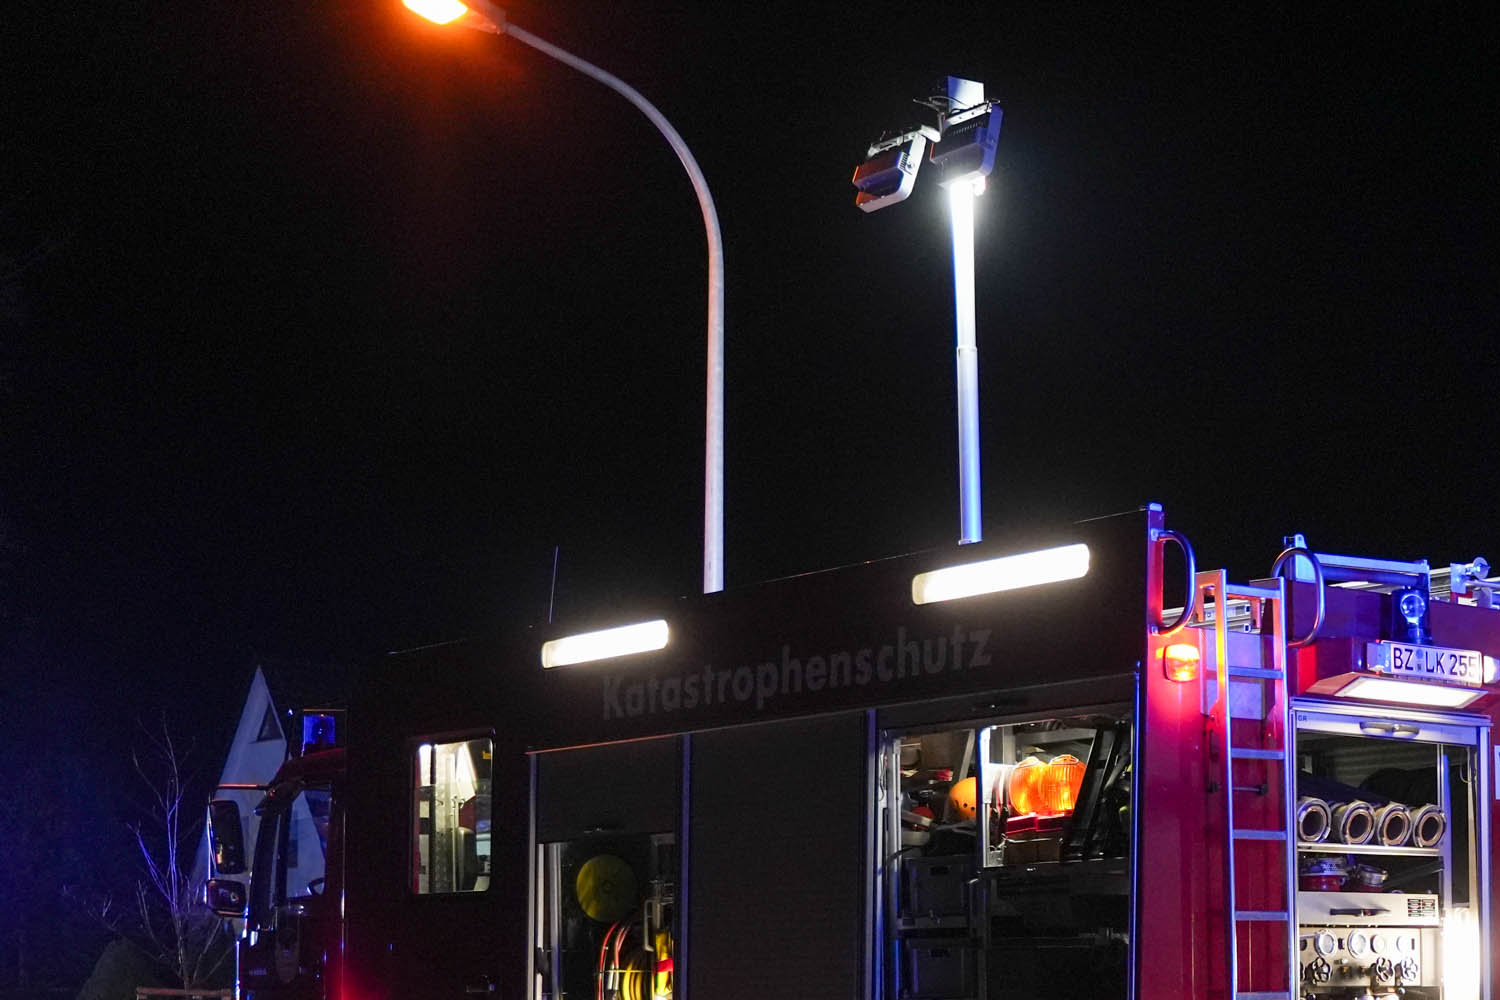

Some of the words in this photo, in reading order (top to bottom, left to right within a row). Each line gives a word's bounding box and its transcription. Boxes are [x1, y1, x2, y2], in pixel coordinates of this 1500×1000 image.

[602, 627, 992, 720] Katastrophenschutz
[1393, 647, 1414, 671] BZ
[1425, 650, 1446, 674] LK
[1449, 654, 1478, 678] 255
